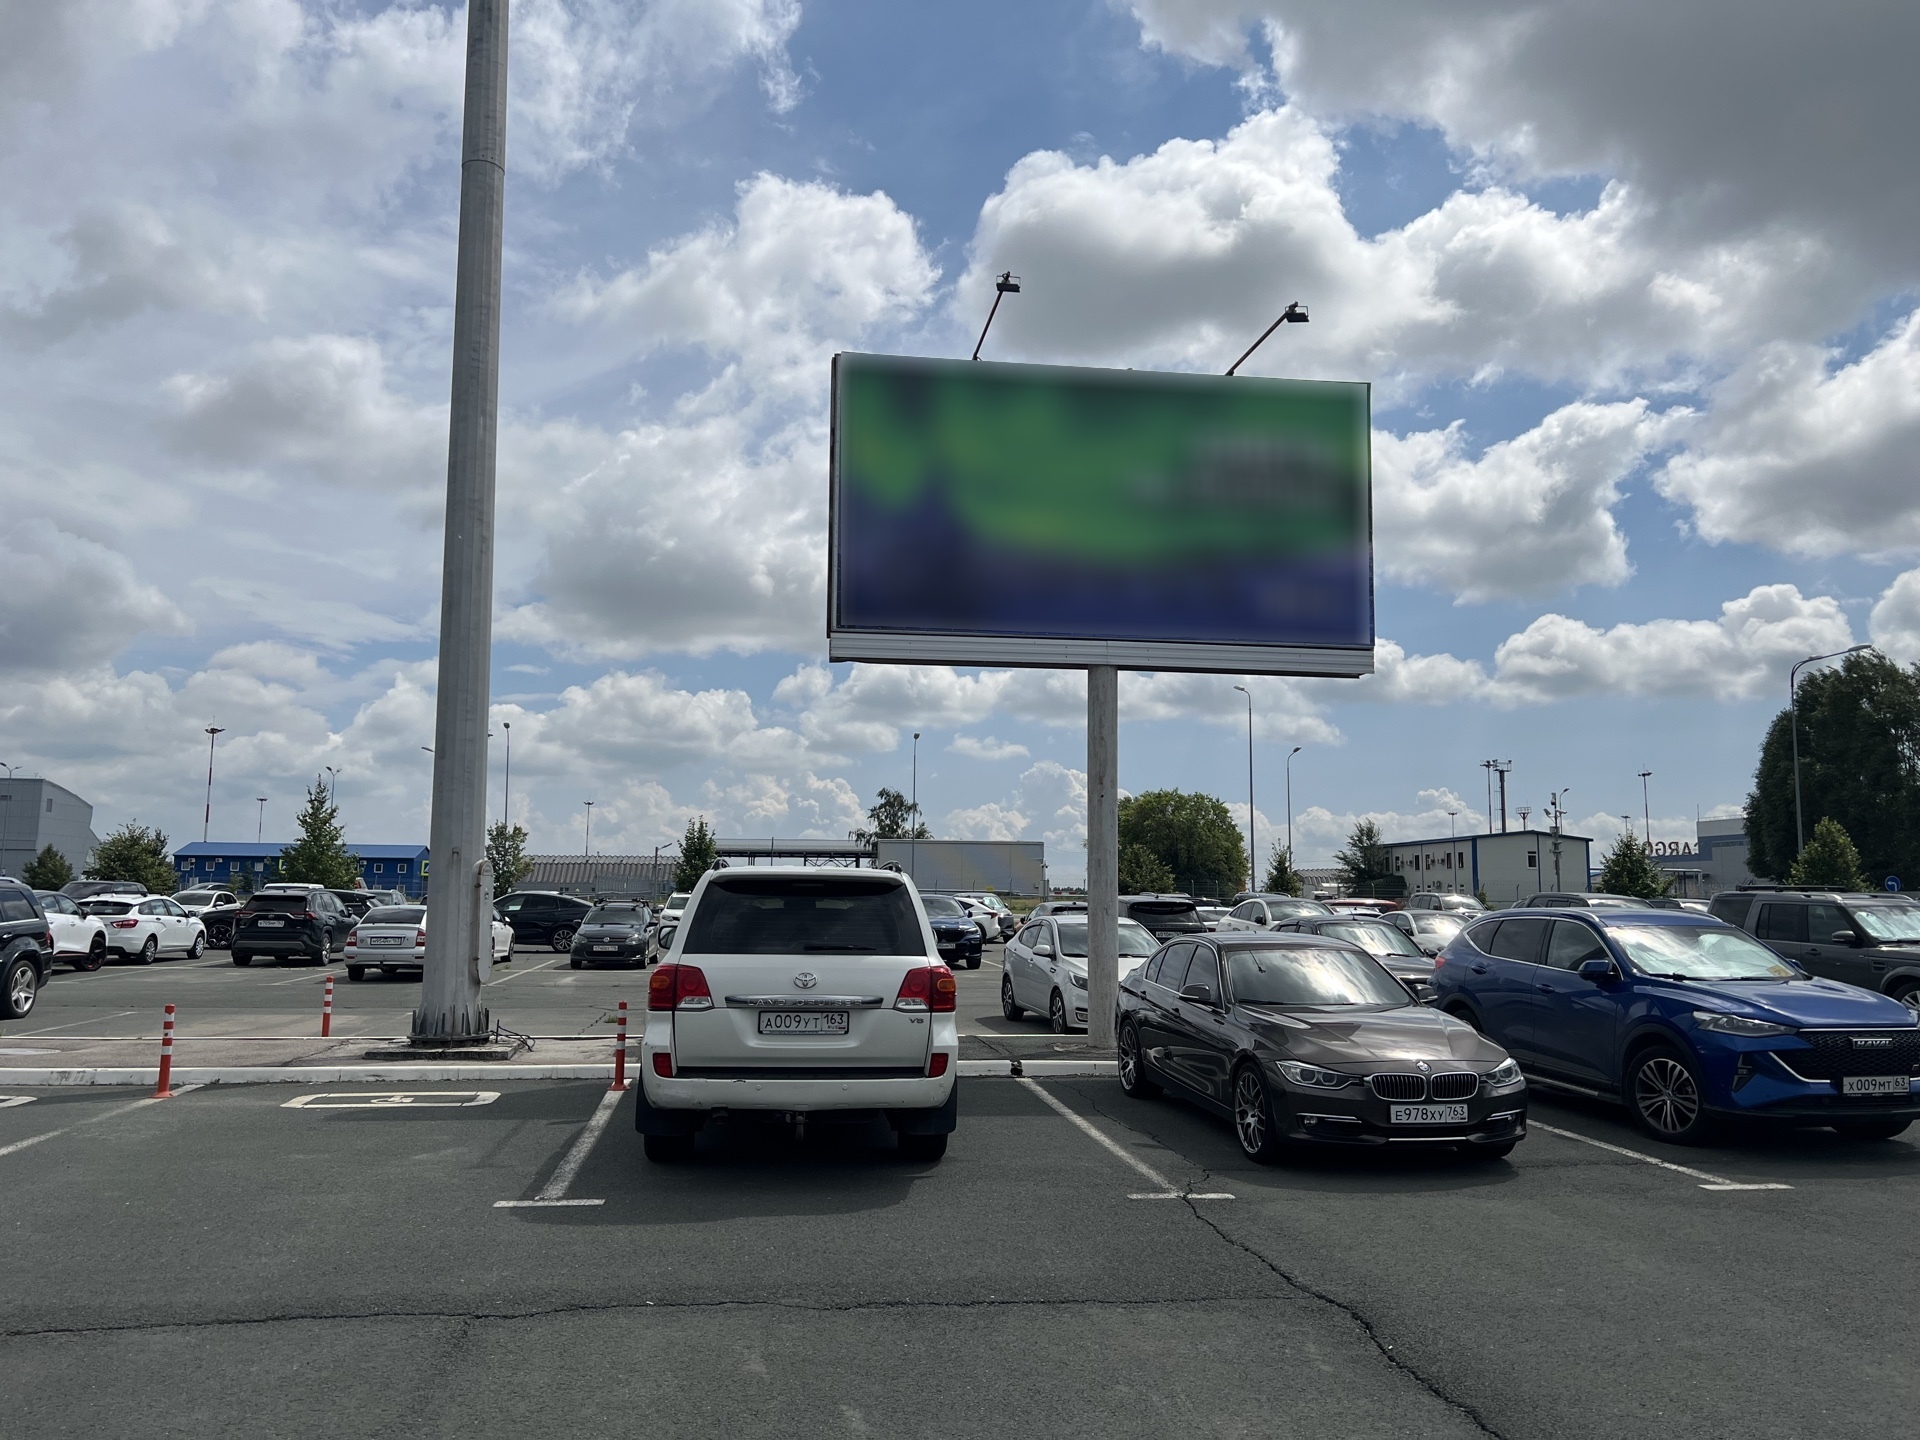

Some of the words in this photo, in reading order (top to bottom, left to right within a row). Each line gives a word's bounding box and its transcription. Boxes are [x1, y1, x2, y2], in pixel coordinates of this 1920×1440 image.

[823, 1013, 845, 1025] 163
[1857, 1040, 1892, 1048] HAVAL
[1894, 1077, 1906, 1087] 63
[1446, 1105, 1465, 1117] 763
